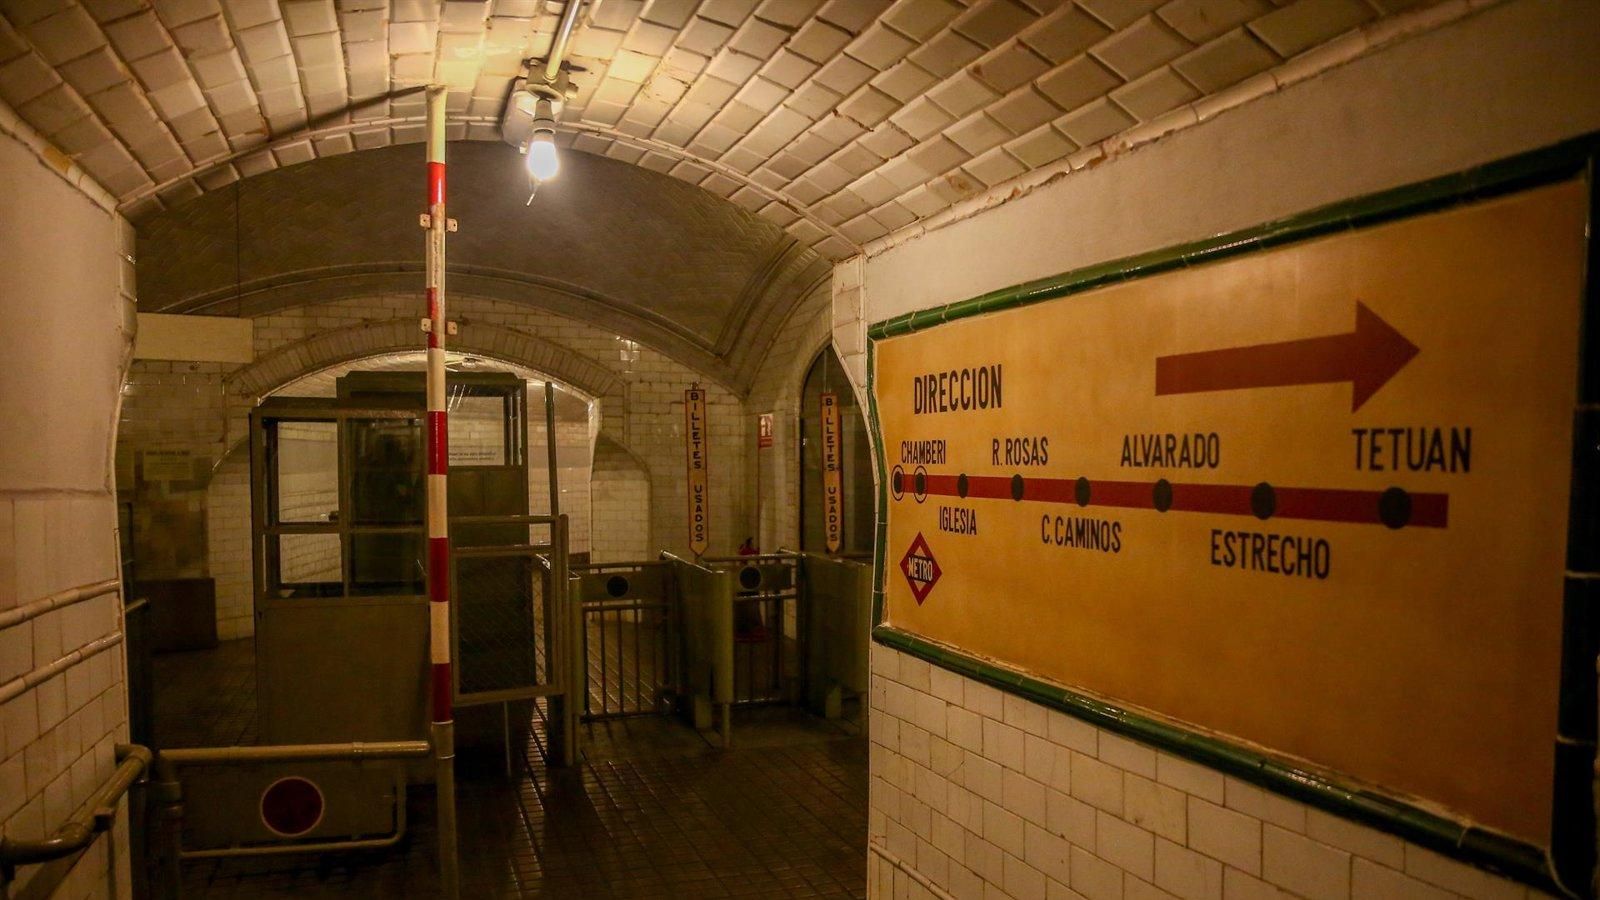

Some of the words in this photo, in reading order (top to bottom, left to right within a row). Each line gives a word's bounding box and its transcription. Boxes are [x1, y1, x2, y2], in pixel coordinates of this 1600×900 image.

[913, 364, 1002, 415] DIRECCION
[690, 392, 702, 469] BILLETES
[826, 398, 836, 472] BILLETES
[900, 439, 947, 465] CHAMBERI
[1004, 436, 1049, 466] ROSAS
[1120, 432, 1220, 469] ALVARADO
[1352, 427, 1472, 473] TETUAN
[694, 484, 704, 542] USADOS
[828, 487, 838, 542] USADOS
[938, 505, 978, 536] IGLESIA
[908, 556, 933, 582] METRO
[1210, 529, 1331, 580] ESTRECHO
